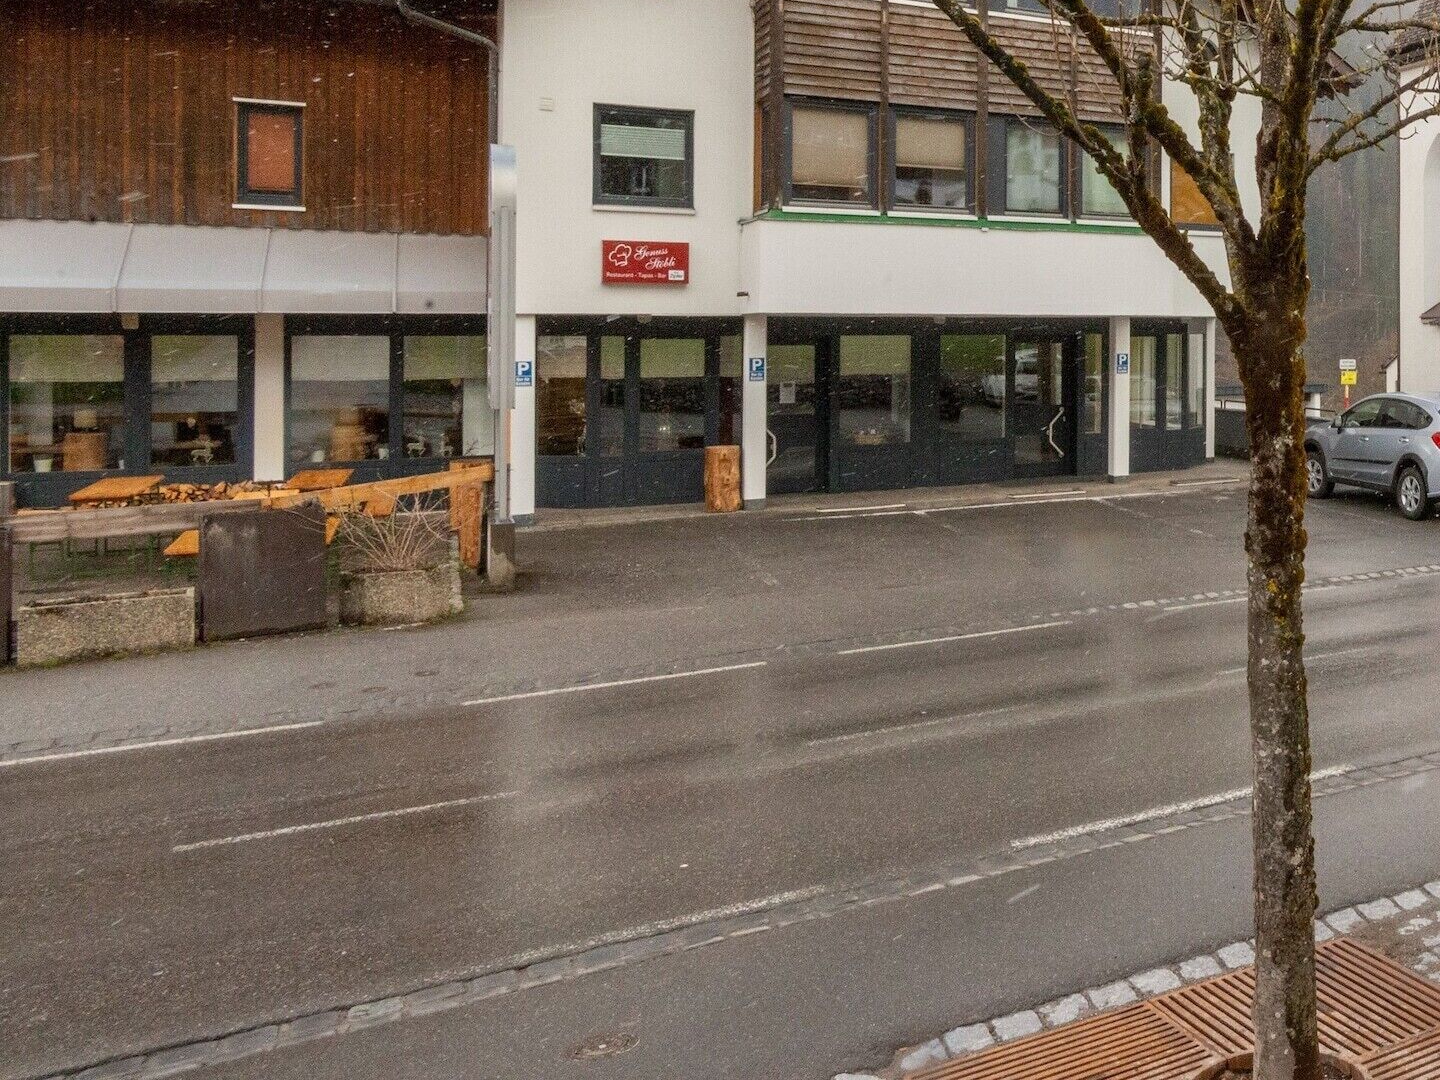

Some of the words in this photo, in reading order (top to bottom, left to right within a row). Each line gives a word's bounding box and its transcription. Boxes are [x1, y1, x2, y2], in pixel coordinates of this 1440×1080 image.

[633, 245, 669, 261] Genuss
[752, 359, 762, 371] P
[1119, 354, 1127, 365] P
[517, 362, 529, 375] P
